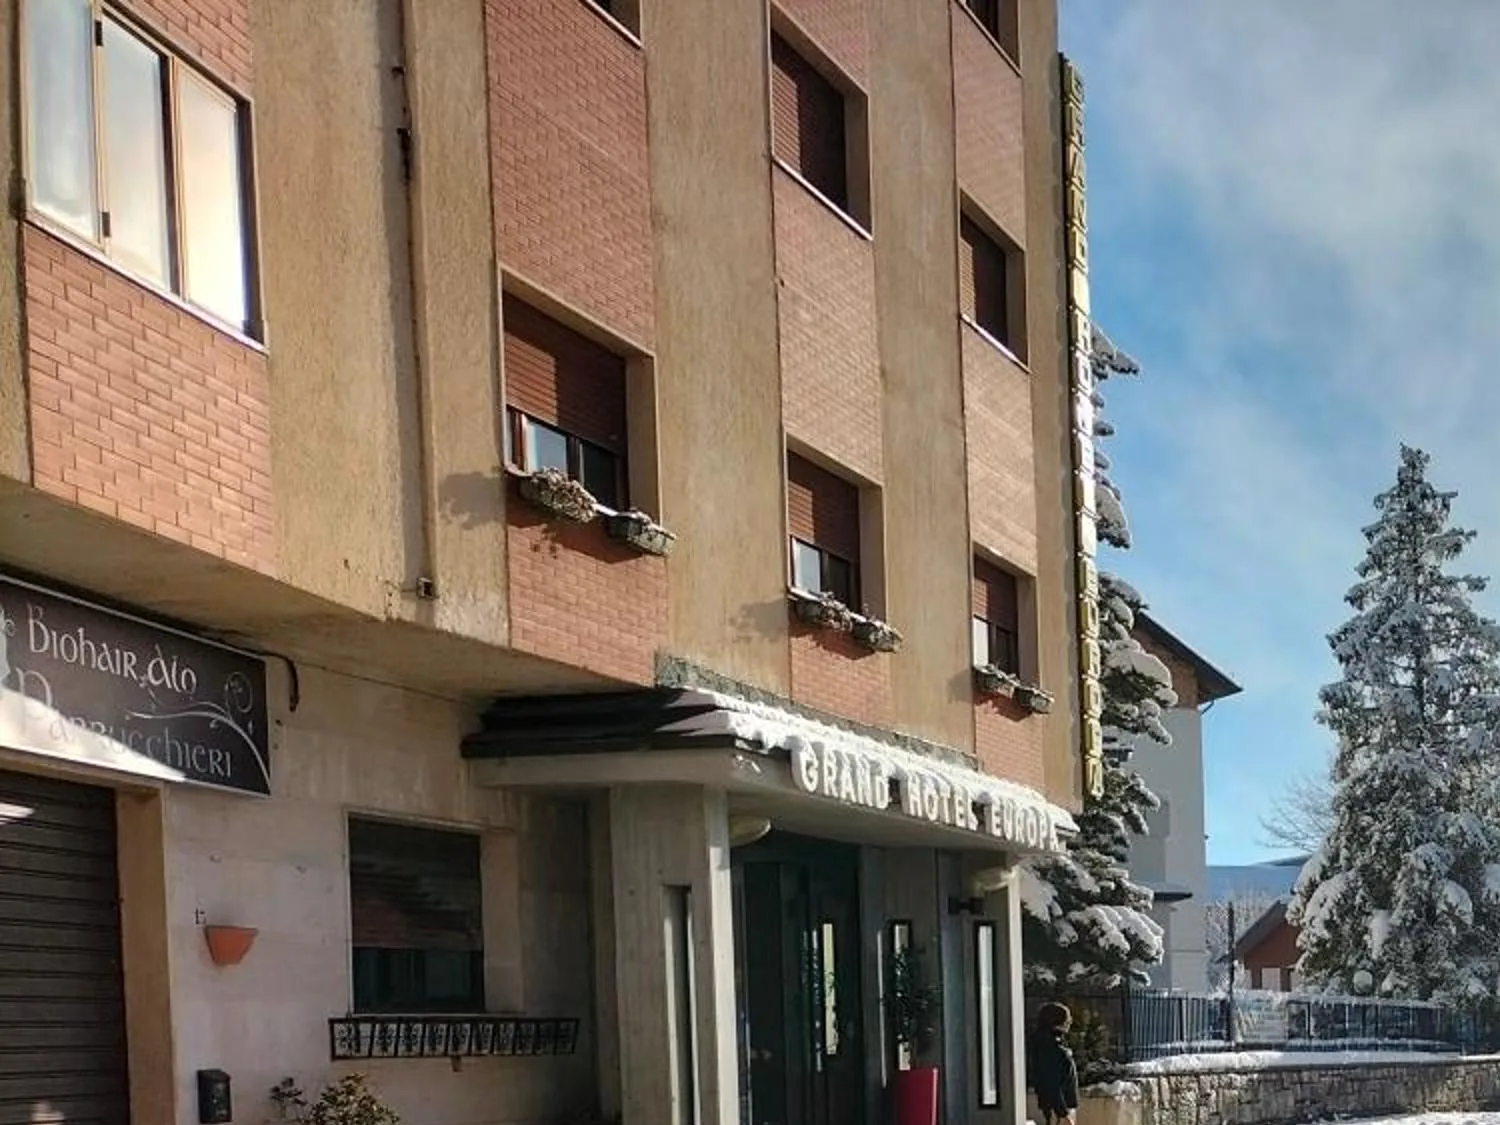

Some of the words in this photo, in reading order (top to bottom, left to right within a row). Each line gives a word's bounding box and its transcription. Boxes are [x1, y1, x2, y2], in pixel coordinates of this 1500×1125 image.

[800, 743, 890, 809] GRAND
[907, 770, 978, 831] HOTEL
[991, 798, 1060, 850] EUROPA
